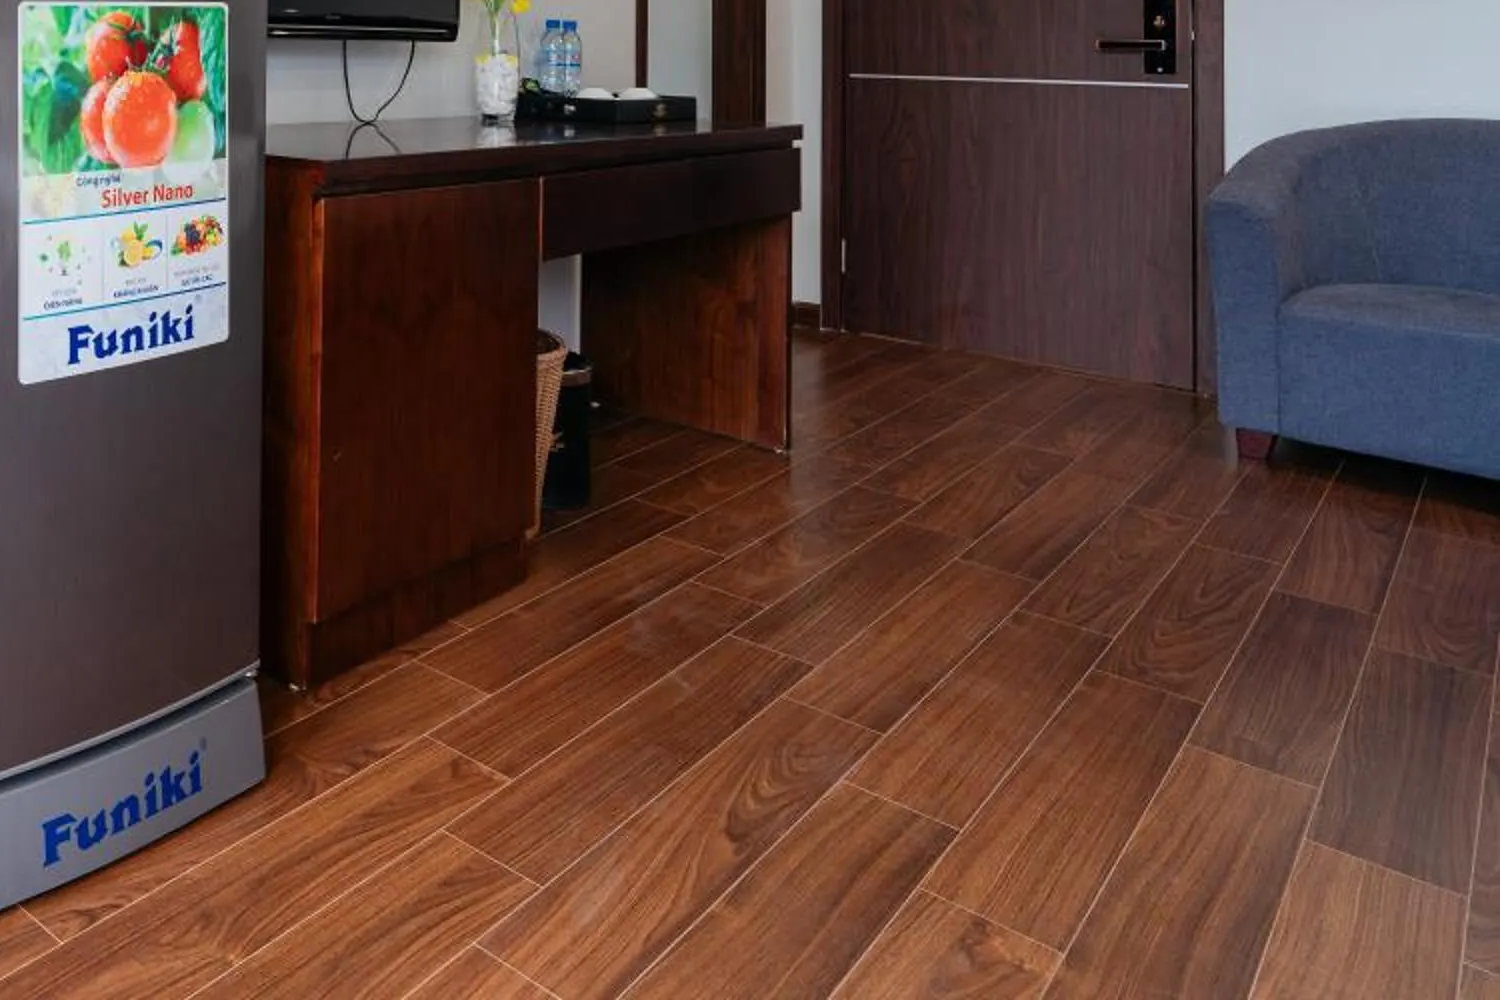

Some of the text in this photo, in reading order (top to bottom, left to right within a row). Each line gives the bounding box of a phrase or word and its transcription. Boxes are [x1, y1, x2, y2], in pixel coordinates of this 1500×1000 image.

[100, 182, 194, 209] Silver Nano
[67, 303, 195, 365] Funiki
[41, 750, 204, 868] Funiki
